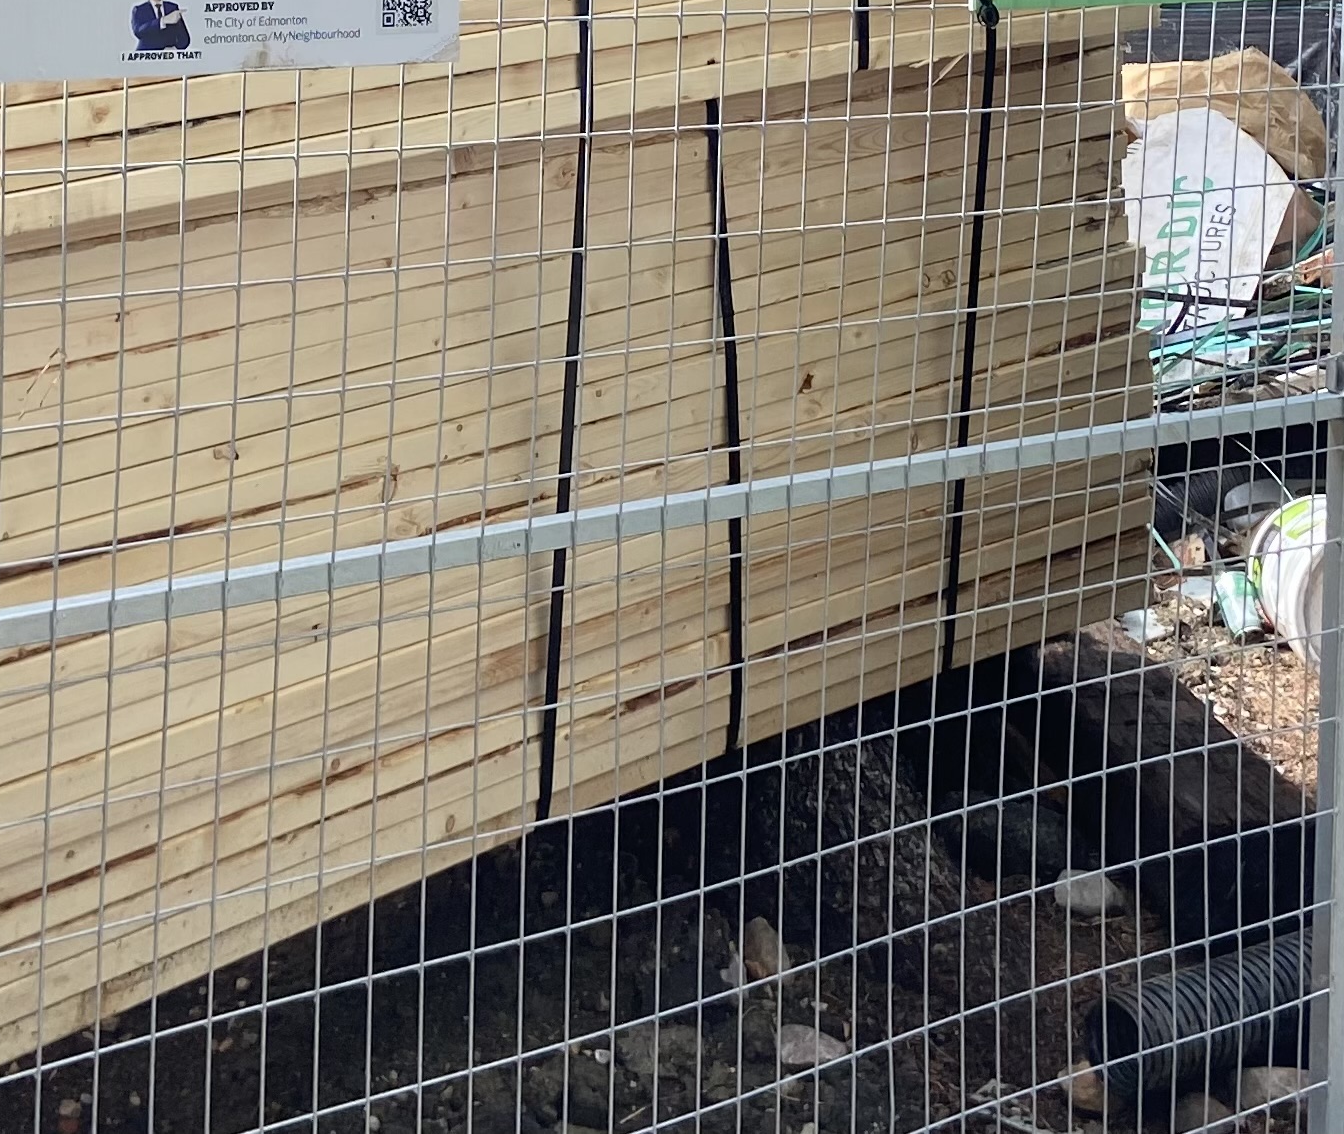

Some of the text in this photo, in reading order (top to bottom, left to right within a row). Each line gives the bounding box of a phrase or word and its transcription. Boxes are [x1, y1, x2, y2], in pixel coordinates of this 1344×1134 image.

[204, 1, 275, 13] APPROVED BY
[204, 15, 308, 29] The City of Edmonton
[203, 28, 361, 44] edmonton.ca/MyNeighbourhood
[127, 52, 175, 61] APPROVED
